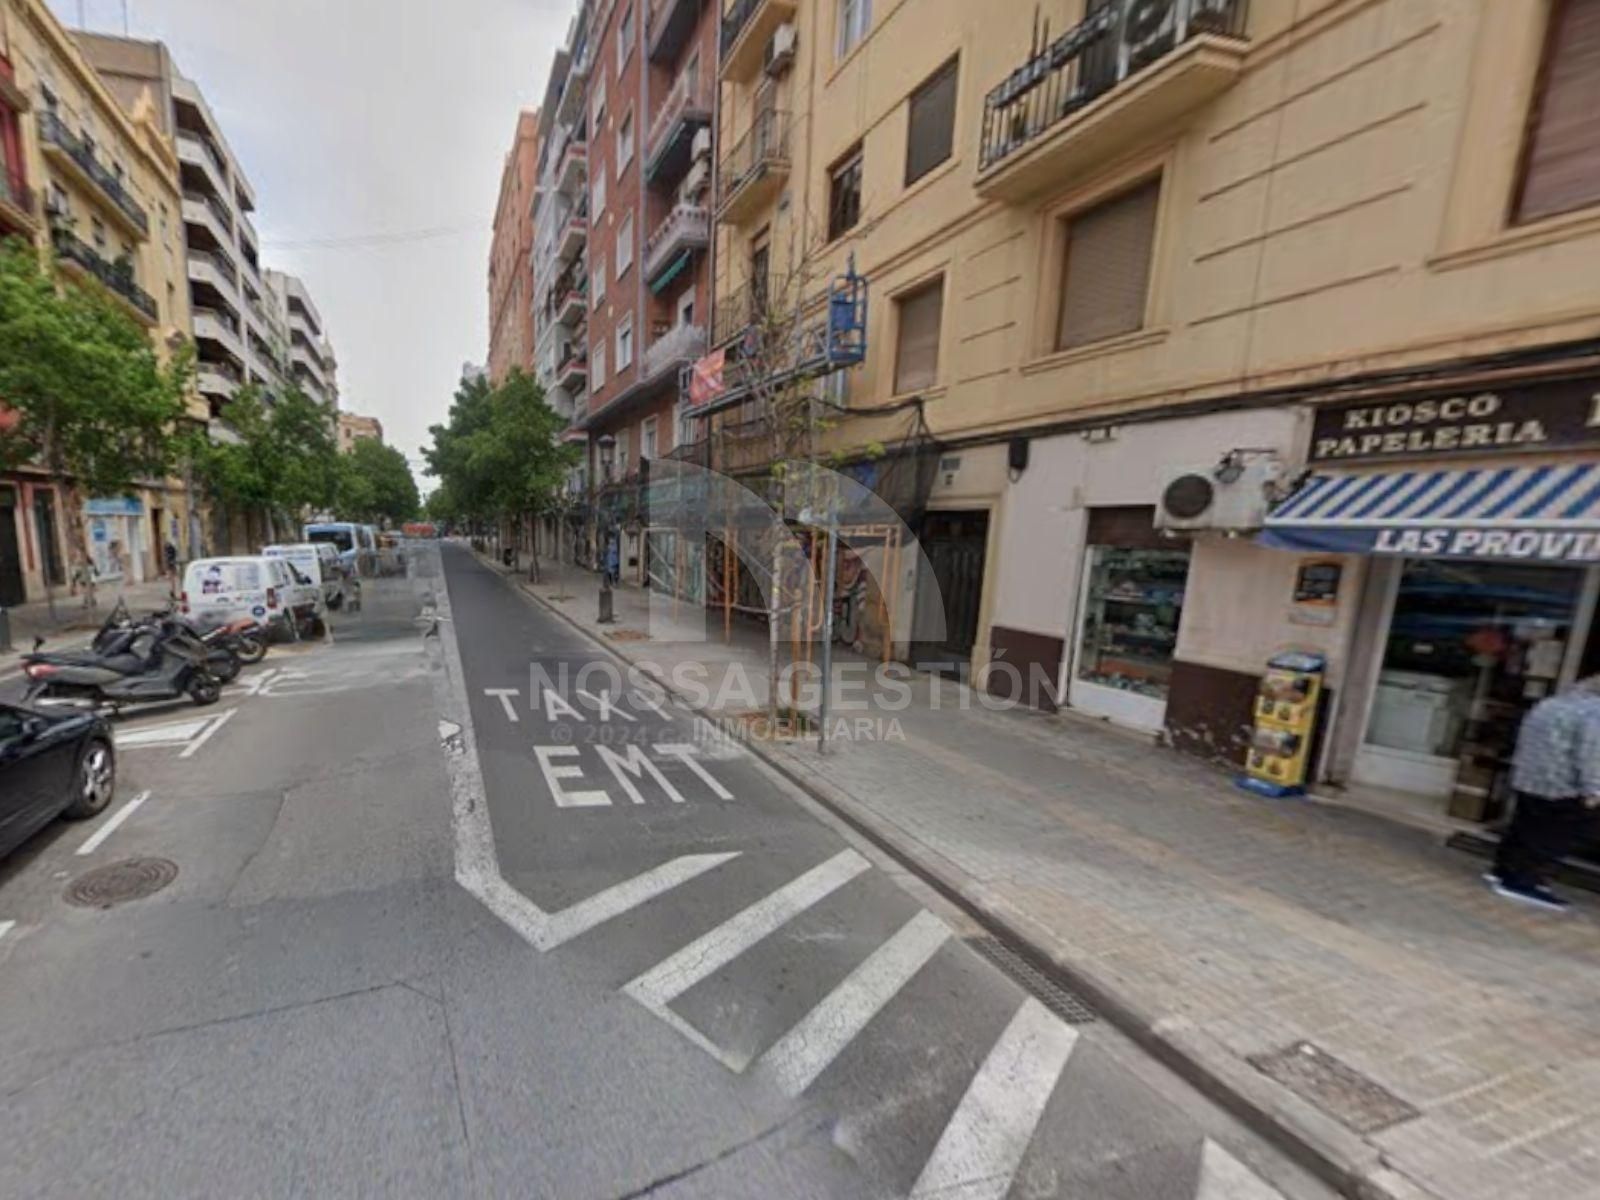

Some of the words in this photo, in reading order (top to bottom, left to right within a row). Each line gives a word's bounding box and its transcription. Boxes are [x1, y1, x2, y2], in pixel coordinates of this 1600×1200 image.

[1343, 393, 1501, 430] KIOSCO
[1314, 420, 1548, 458] PAPELERIA
[1372, 529, 1451, 553] LAS
[484, 687, 673, 722] TAXI
[533, 743, 735, 808] EMT
